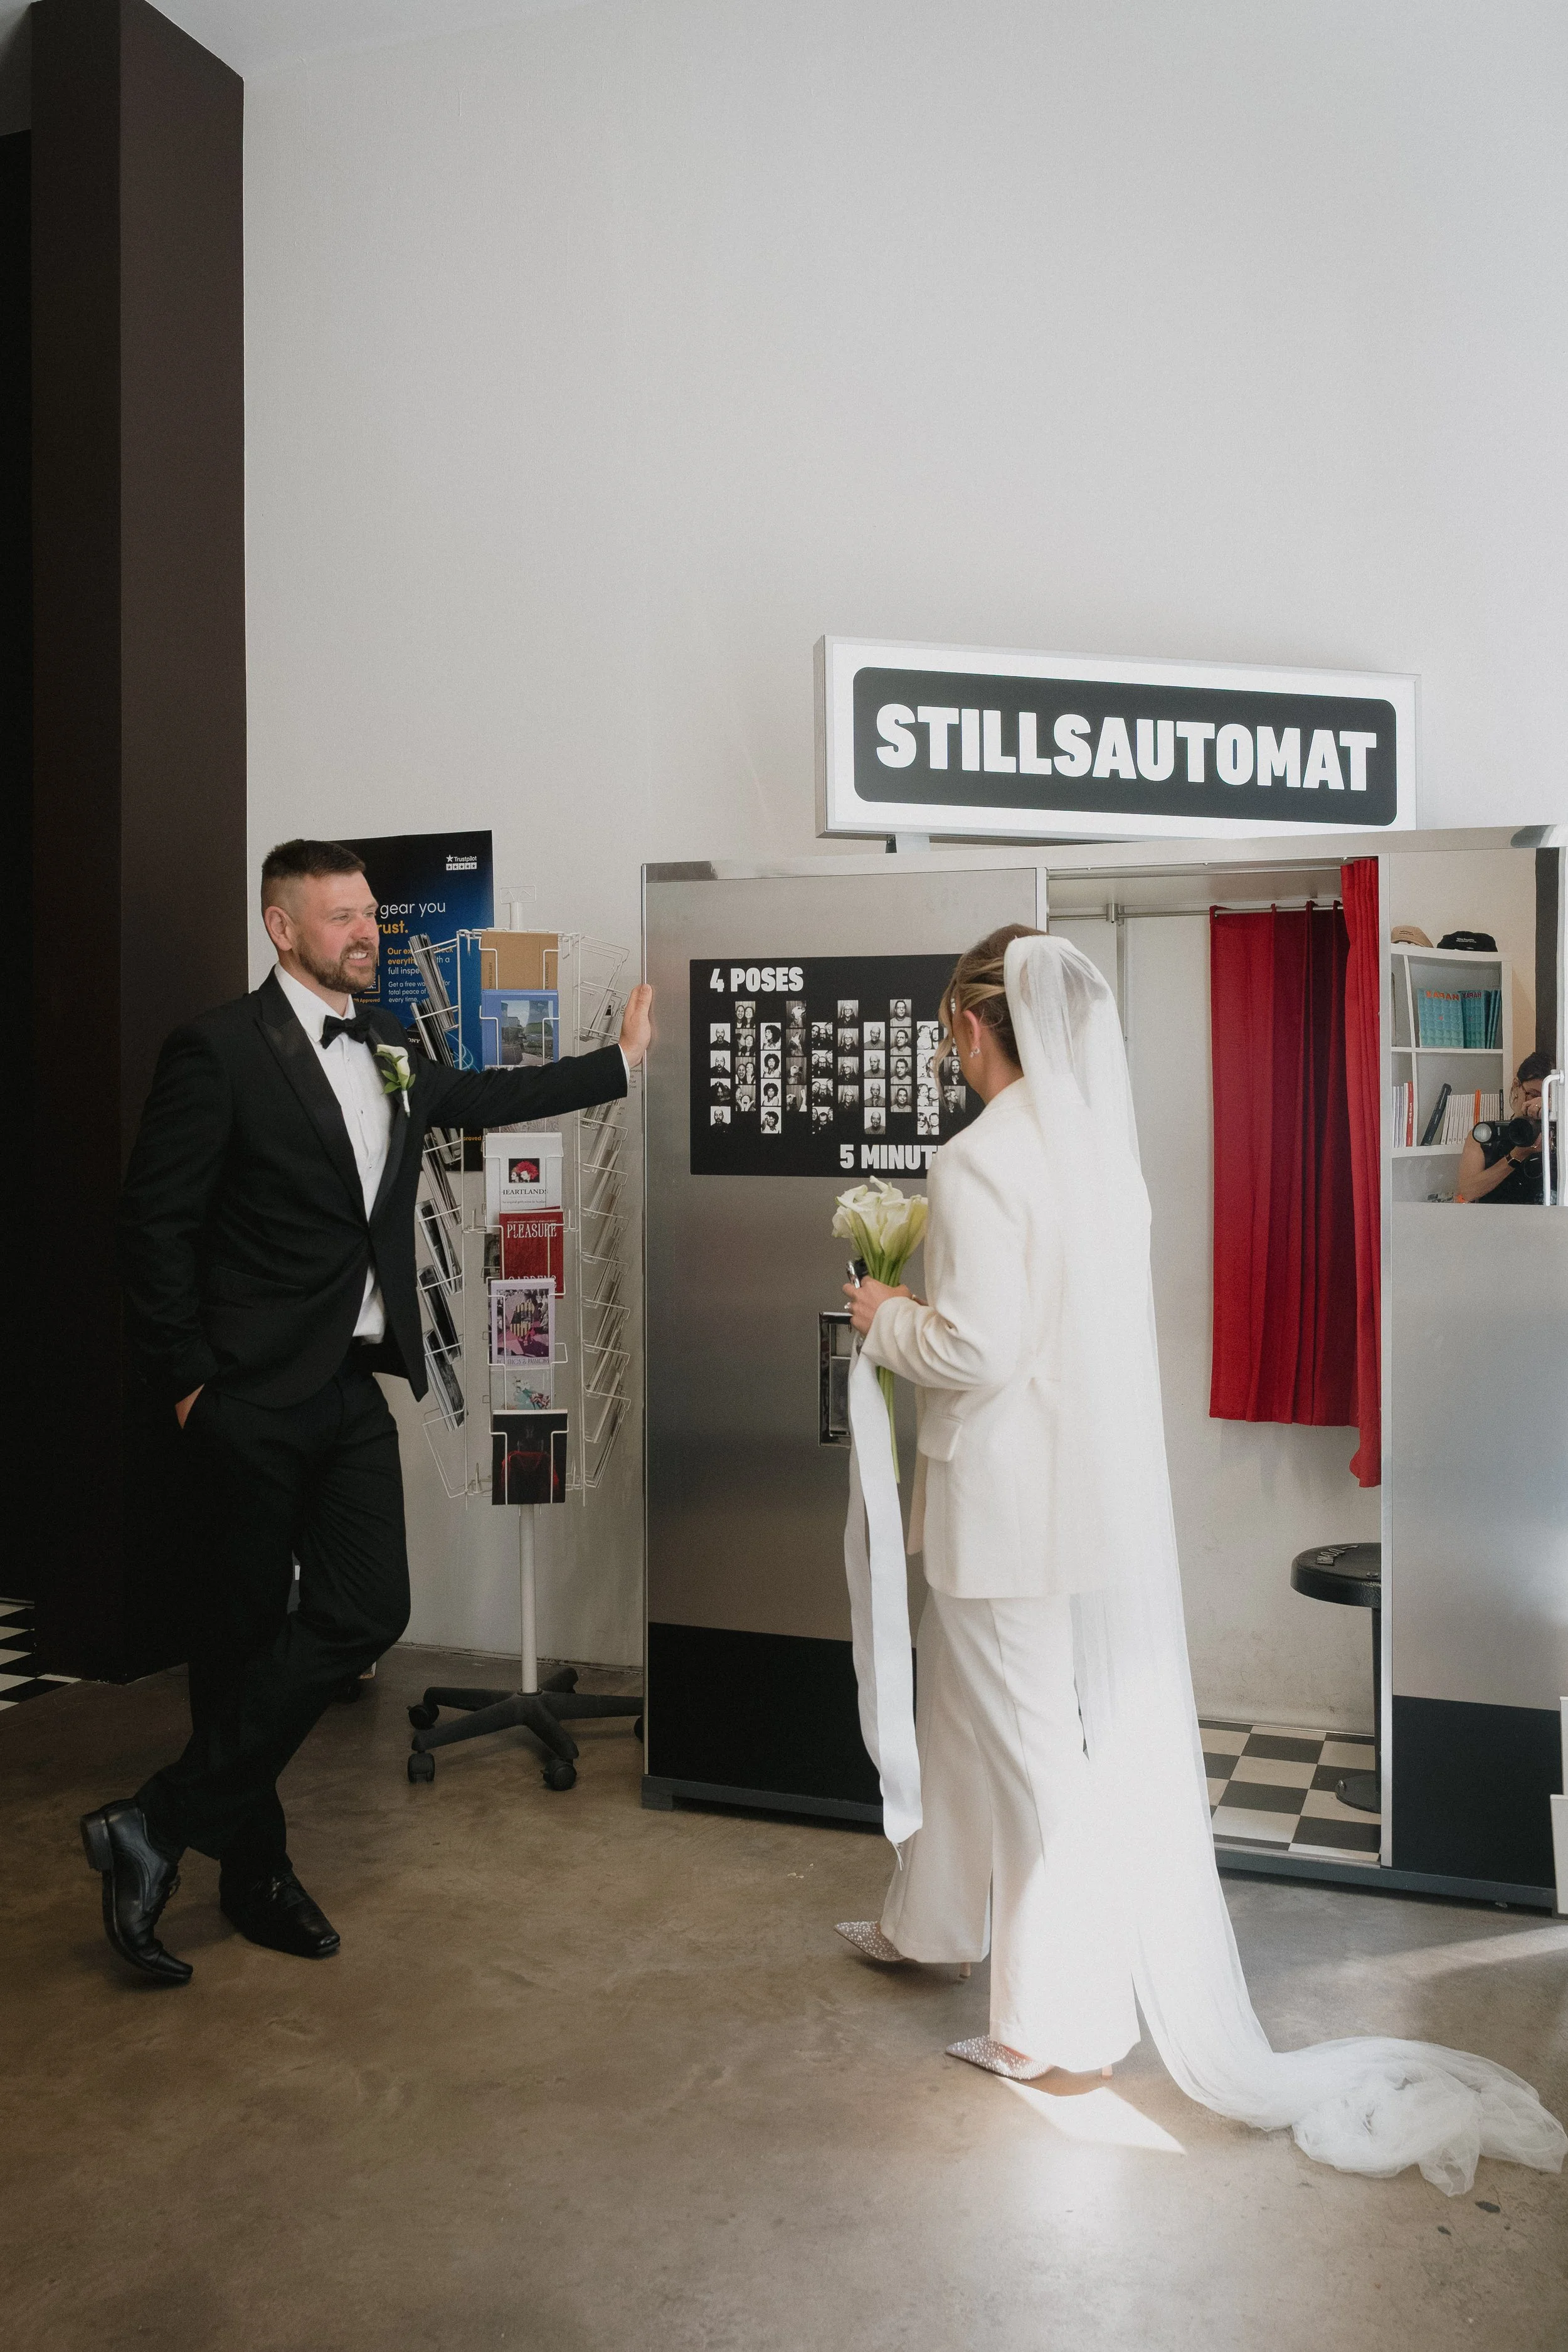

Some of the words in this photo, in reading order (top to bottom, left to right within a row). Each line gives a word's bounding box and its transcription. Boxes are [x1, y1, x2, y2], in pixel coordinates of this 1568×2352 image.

[876, 702, 1377, 792] STILLSAUTOMAT
[379, 904, 415, 919] gear
[419, 903, 446, 918] you
[377, 920, 409, 934] rust.
[387, 957, 415, 967] everyth
[401, 967, 420, 976] inspe
[710, 968, 724, 992] 4
[730, 967, 804, 992] POSES
[840, 1144, 854, 1169] 5
[861, 1144, 943, 1170] MINUT
[506, 1223, 557, 1239] PLEASURE
